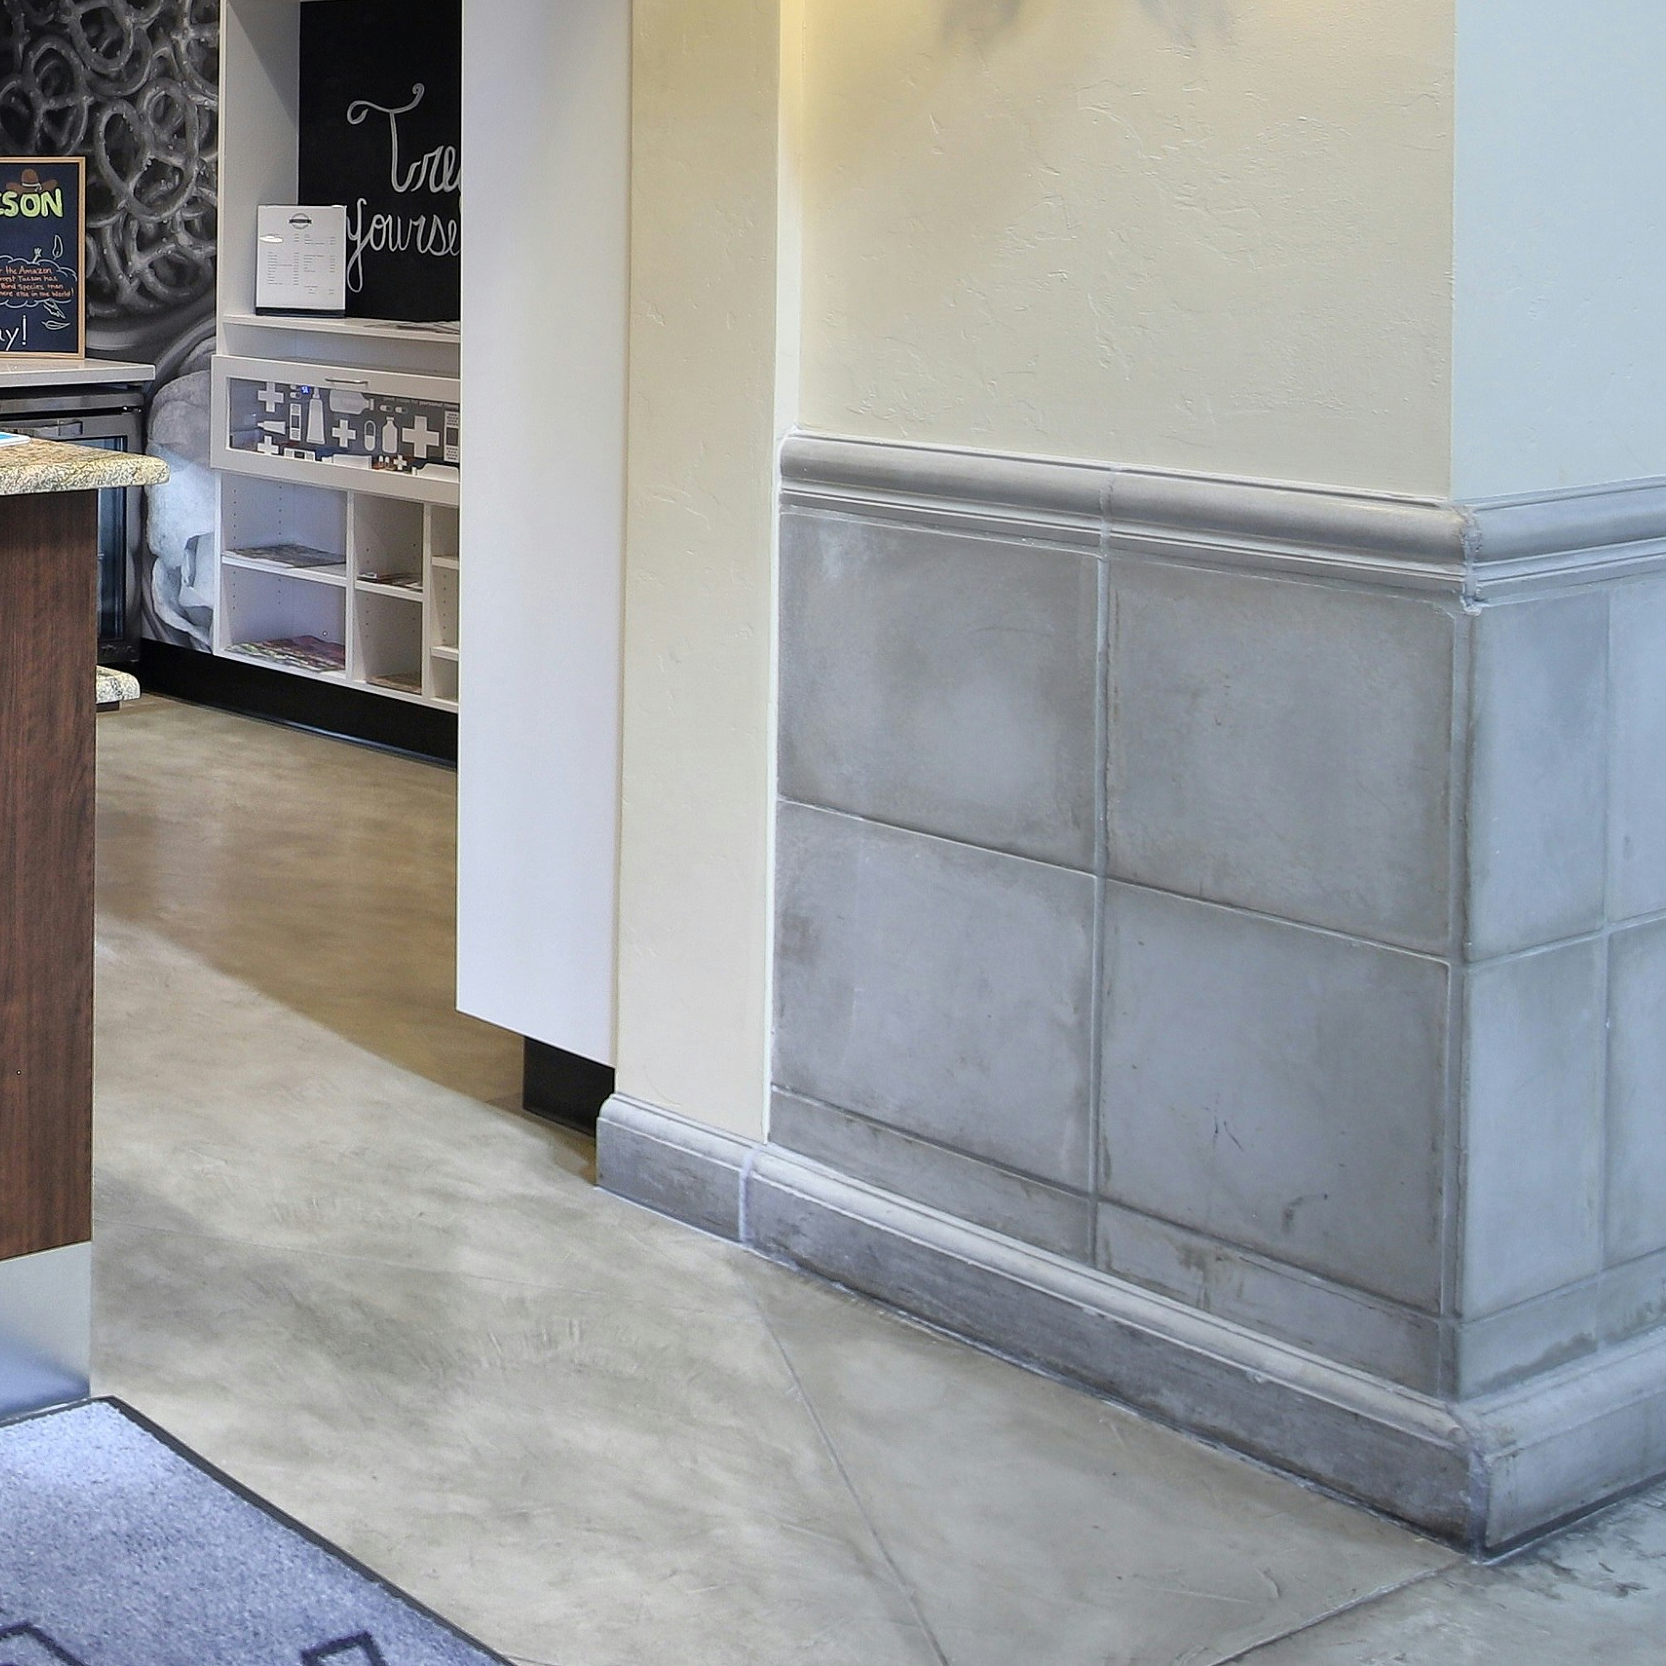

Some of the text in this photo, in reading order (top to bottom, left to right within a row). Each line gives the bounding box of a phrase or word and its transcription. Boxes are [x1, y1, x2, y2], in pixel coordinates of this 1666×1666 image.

[347, 82, 462, 193] Tre
[6, 265, 17, 274] the
[18, 265, 53, 274] Amazon
[346, 197, 461, 293] yourse
